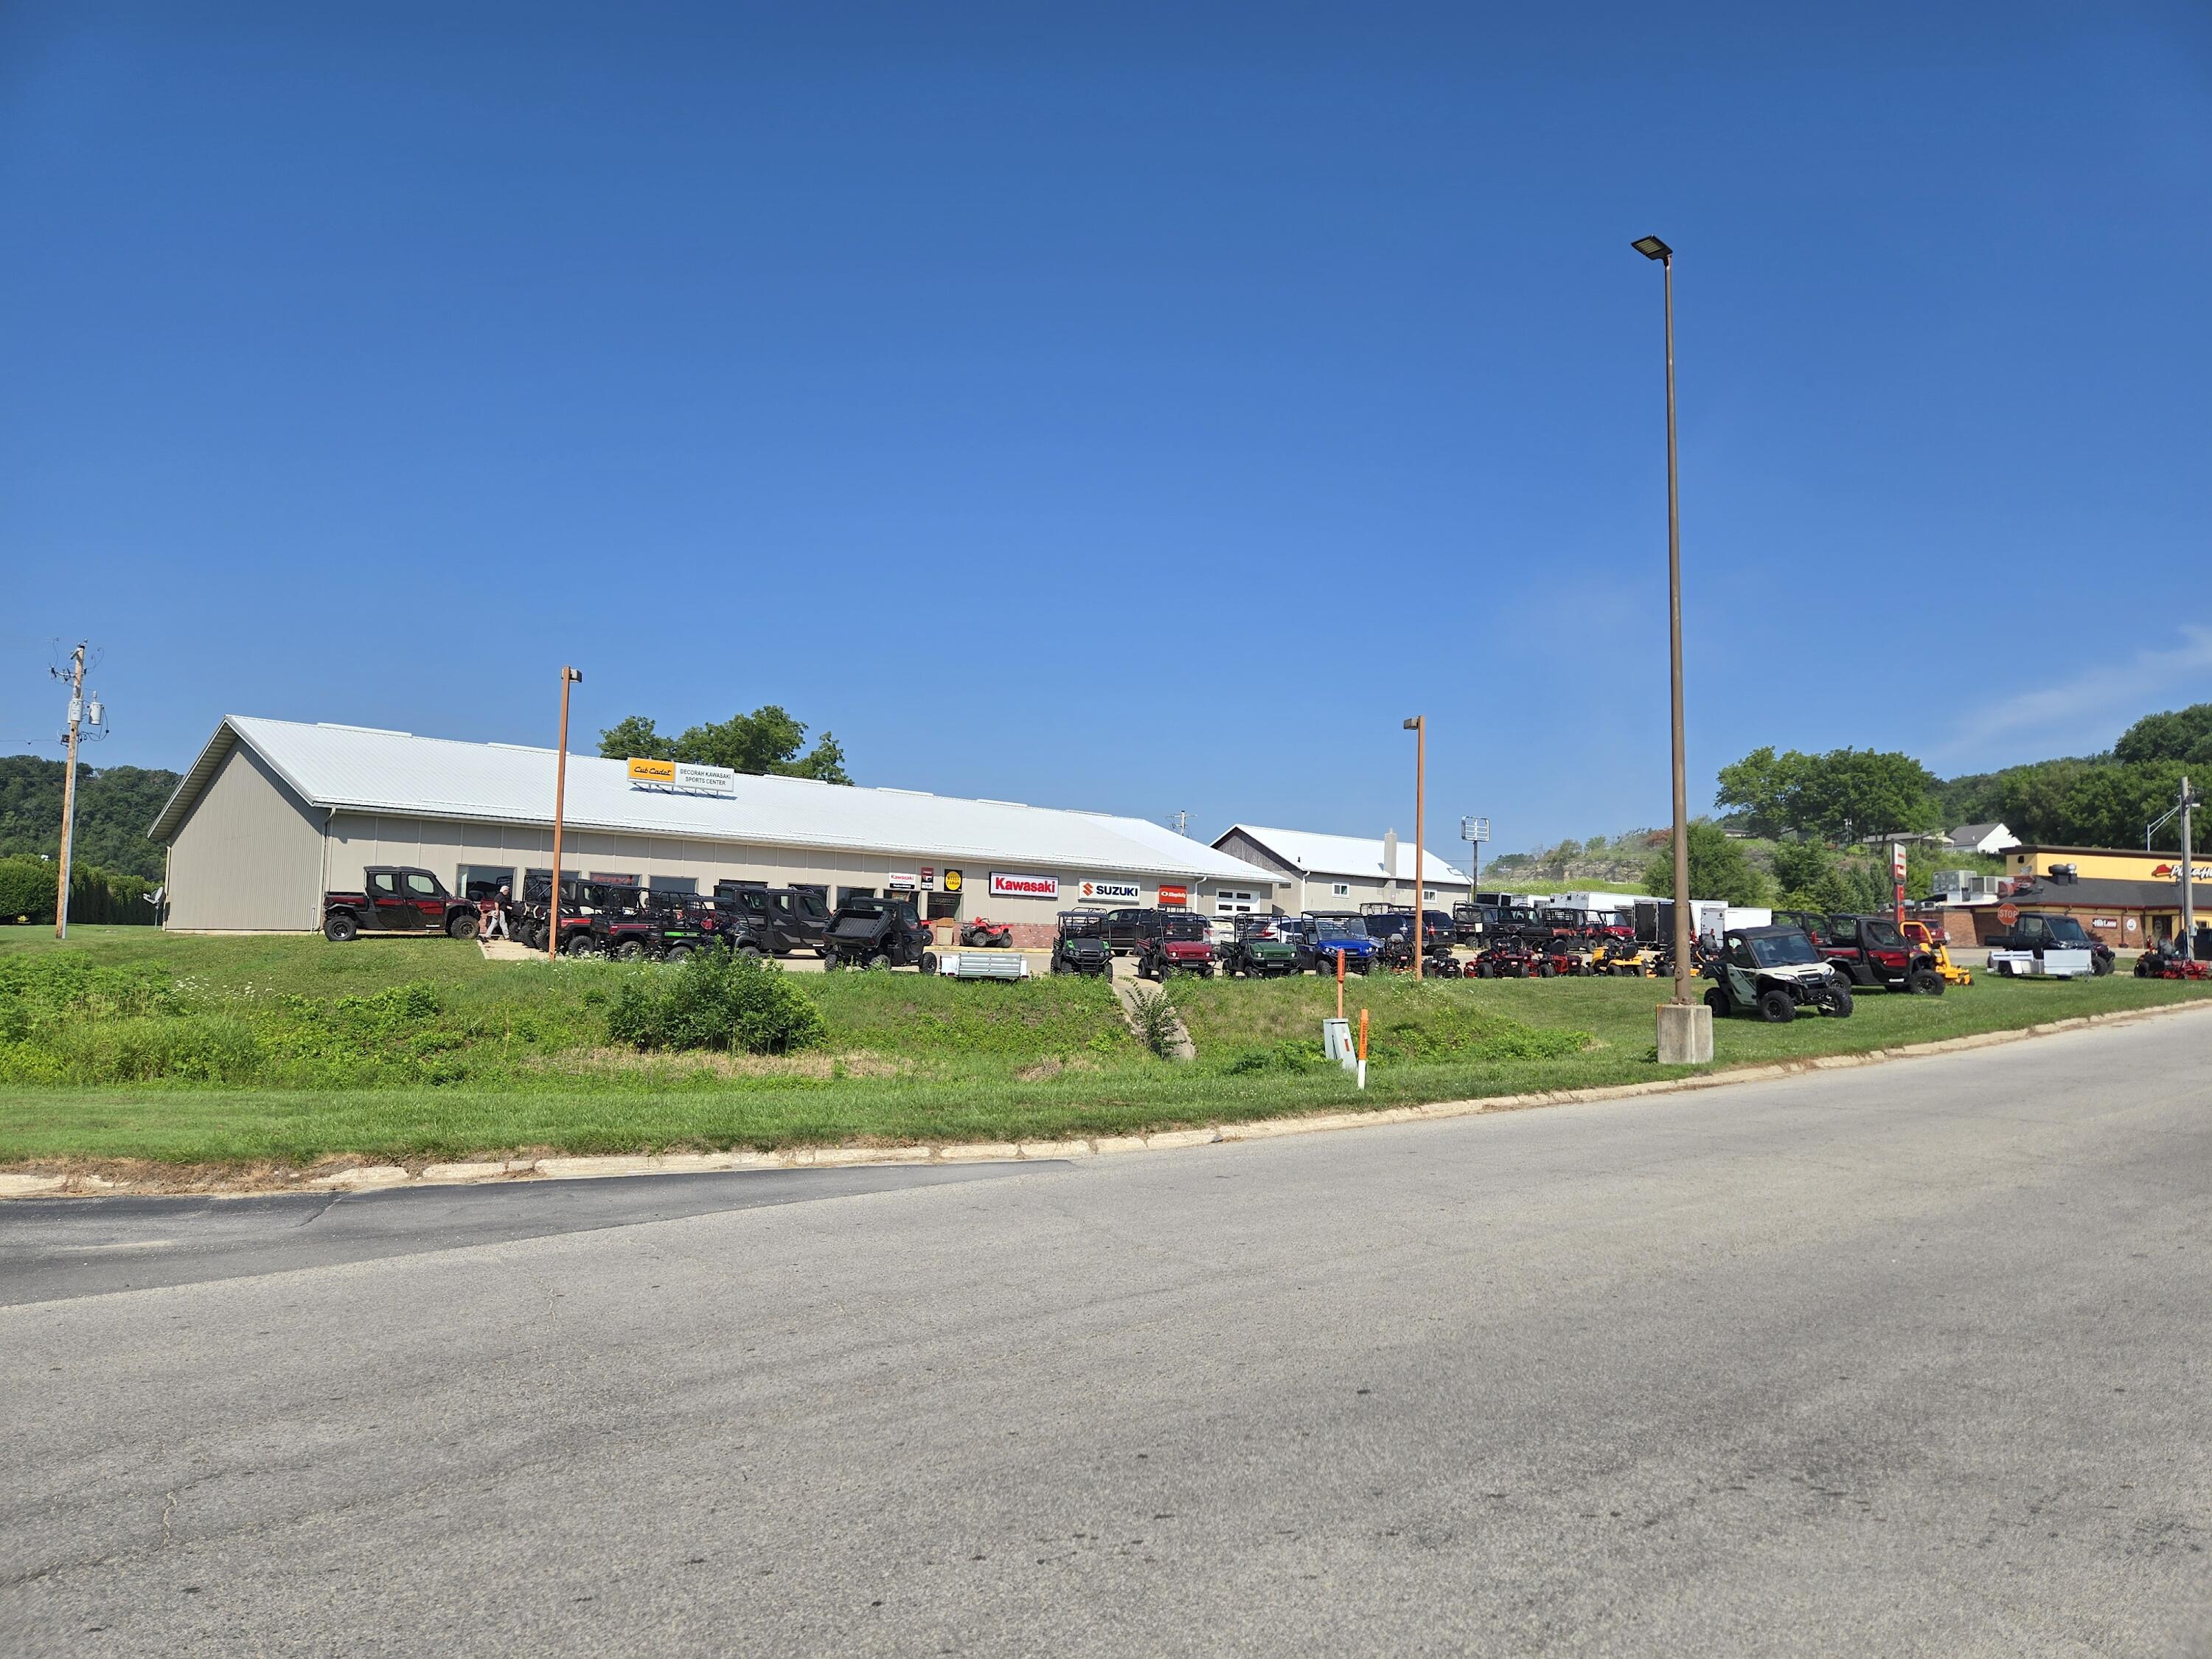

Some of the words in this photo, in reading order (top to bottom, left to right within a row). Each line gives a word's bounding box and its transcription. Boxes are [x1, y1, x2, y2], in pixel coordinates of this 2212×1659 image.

[649, 768, 672, 776] Cadet
[680, 768, 705, 776] DECORAH
[705, 771, 731, 779] KAWASAKI
[2170, 865, 2200, 877] Pia
[995, 877, 1056, 893] Kawasaki
[1096, 886, 1138, 897] SUZUKI
[1999, 908, 2018, 918] STOP
